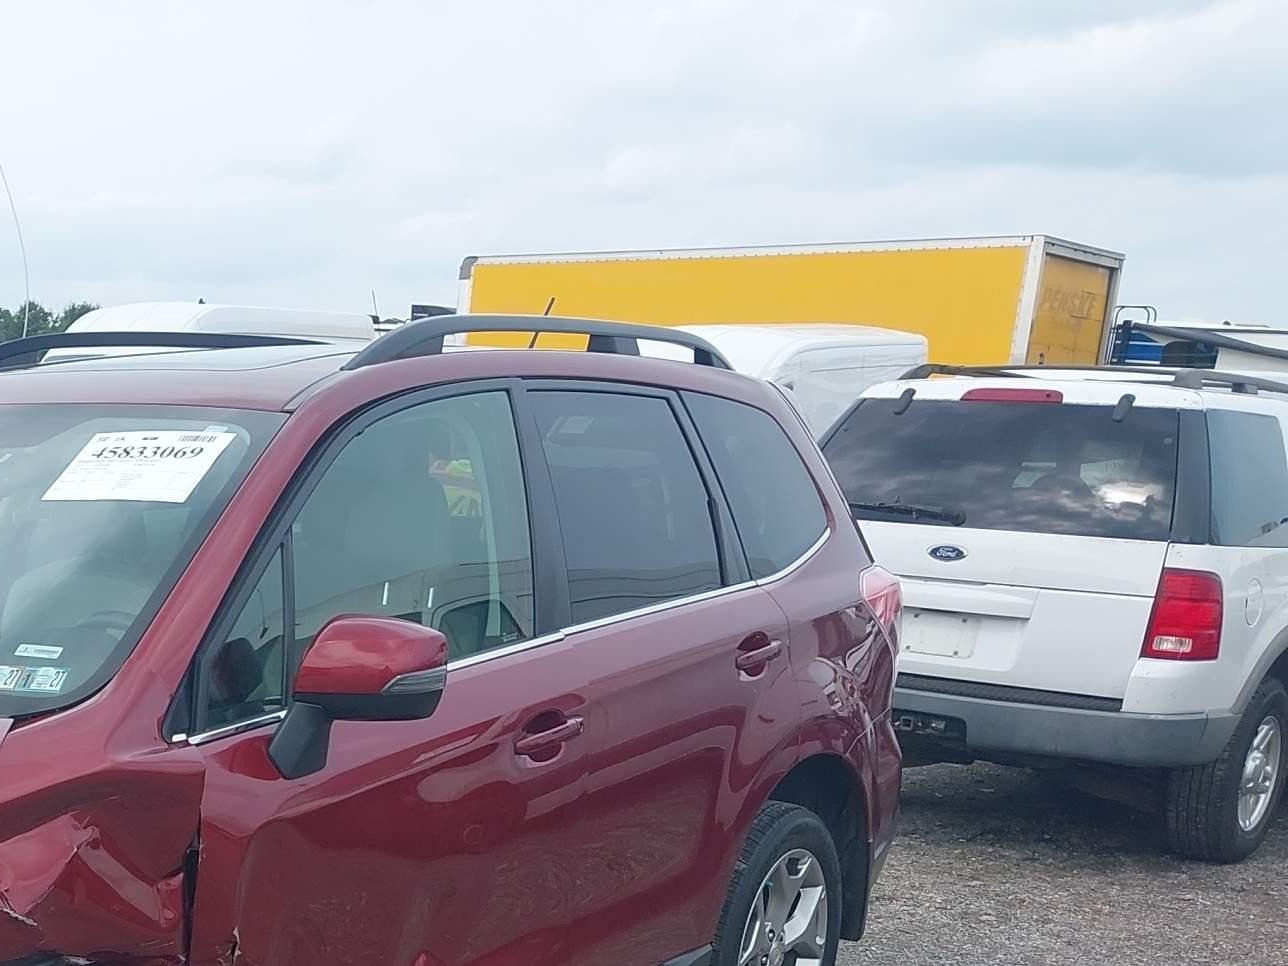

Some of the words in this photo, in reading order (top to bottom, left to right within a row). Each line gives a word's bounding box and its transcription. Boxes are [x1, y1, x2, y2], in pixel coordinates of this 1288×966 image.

[91, 446, 204, 459] 45833069
[936, 547, 958, 558] Ford
[3, 669, 20, 688] 27
[49, 670, 66, 689] 27
